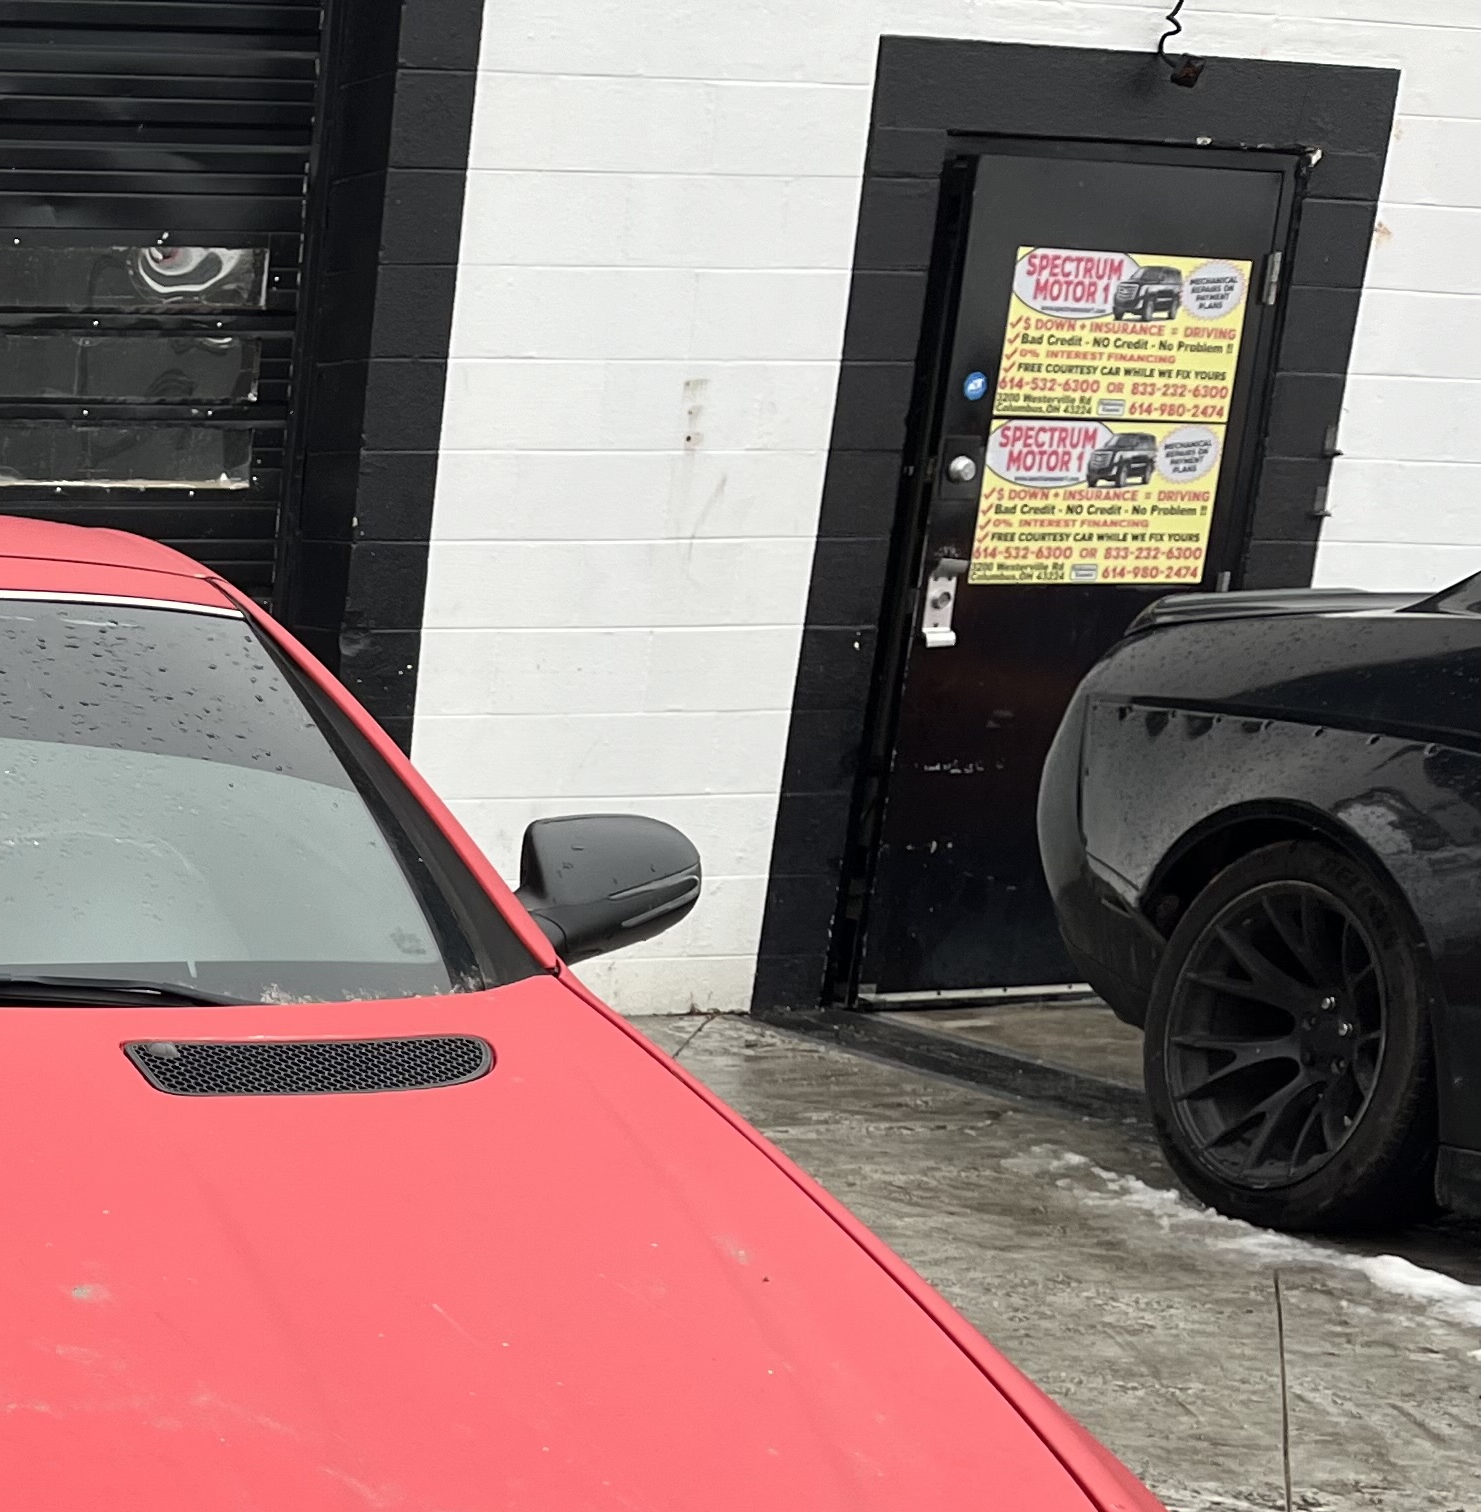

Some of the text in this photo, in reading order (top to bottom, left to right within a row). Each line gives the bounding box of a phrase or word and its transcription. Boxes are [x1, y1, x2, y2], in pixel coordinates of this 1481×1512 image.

[1026, 254, 1125, 280] SPECTRUM
[1033, 278, 1110, 304] MOTOR 1
[1023, 317, 1031, 330] $
[1035, 319, 1077, 331] DOWN
[1090, 321, 1165, 337] INSURANCE
[1184, 326, 1236, 340] DRIVING
[1021, 333, 1044, 344] Bad
[1047, 334, 1082, 346] Credit
[1092, 337, 1110, 348] NO
[1114, 338, 1148, 350] Credit
[1159, 340, 1174, 351] No
[1177, 341, 1223, 353] Problem
[1019, 348, 1175, 364] 0% INTEREST FINANCING
[1017, 363, 1226, 381] FREE COURTESY CAR WHILE WE FIX YOURS
[999, 376, 1229, 399] 614-532-6300 OR 833-232-6300
[1079, 396, 1092, 405] Rd
[1129, 402, 1224, 418] 614-980-2474
[999, 425, 1098, 449] SPECTRUM
[1007, 449, 1084, 472] MOTOR 1
[997, 488, 1004, 501] $
[1008, 489, 1050, 501] DOWN
[1063, 490, 1139, 501] INSURANCE
[1158, 490, 1210, 502] DRIVING
[994, 504, 1017, 514] Bad
[1020, 504, 1056, 515] Credit
[1065, 504, 1083, 514] NO
[1087, 504, 1122, 515] Credit
[1131, 505, 1147, 515] No
[1150, 505, 1197, 516] Problem
[992, 519, 1149, 528] 0% INTEREST FINANCING
[991, 532, 1200, 542] FREE COURTESY CAR WHILE WE FIX YOURS
[973, 546, 1202, 560] 614-532-6300 OR 833-232-6300
[1052, 562, 1064, 570] Rd
[1102, 566, 1199, 579] 614-980-2474
